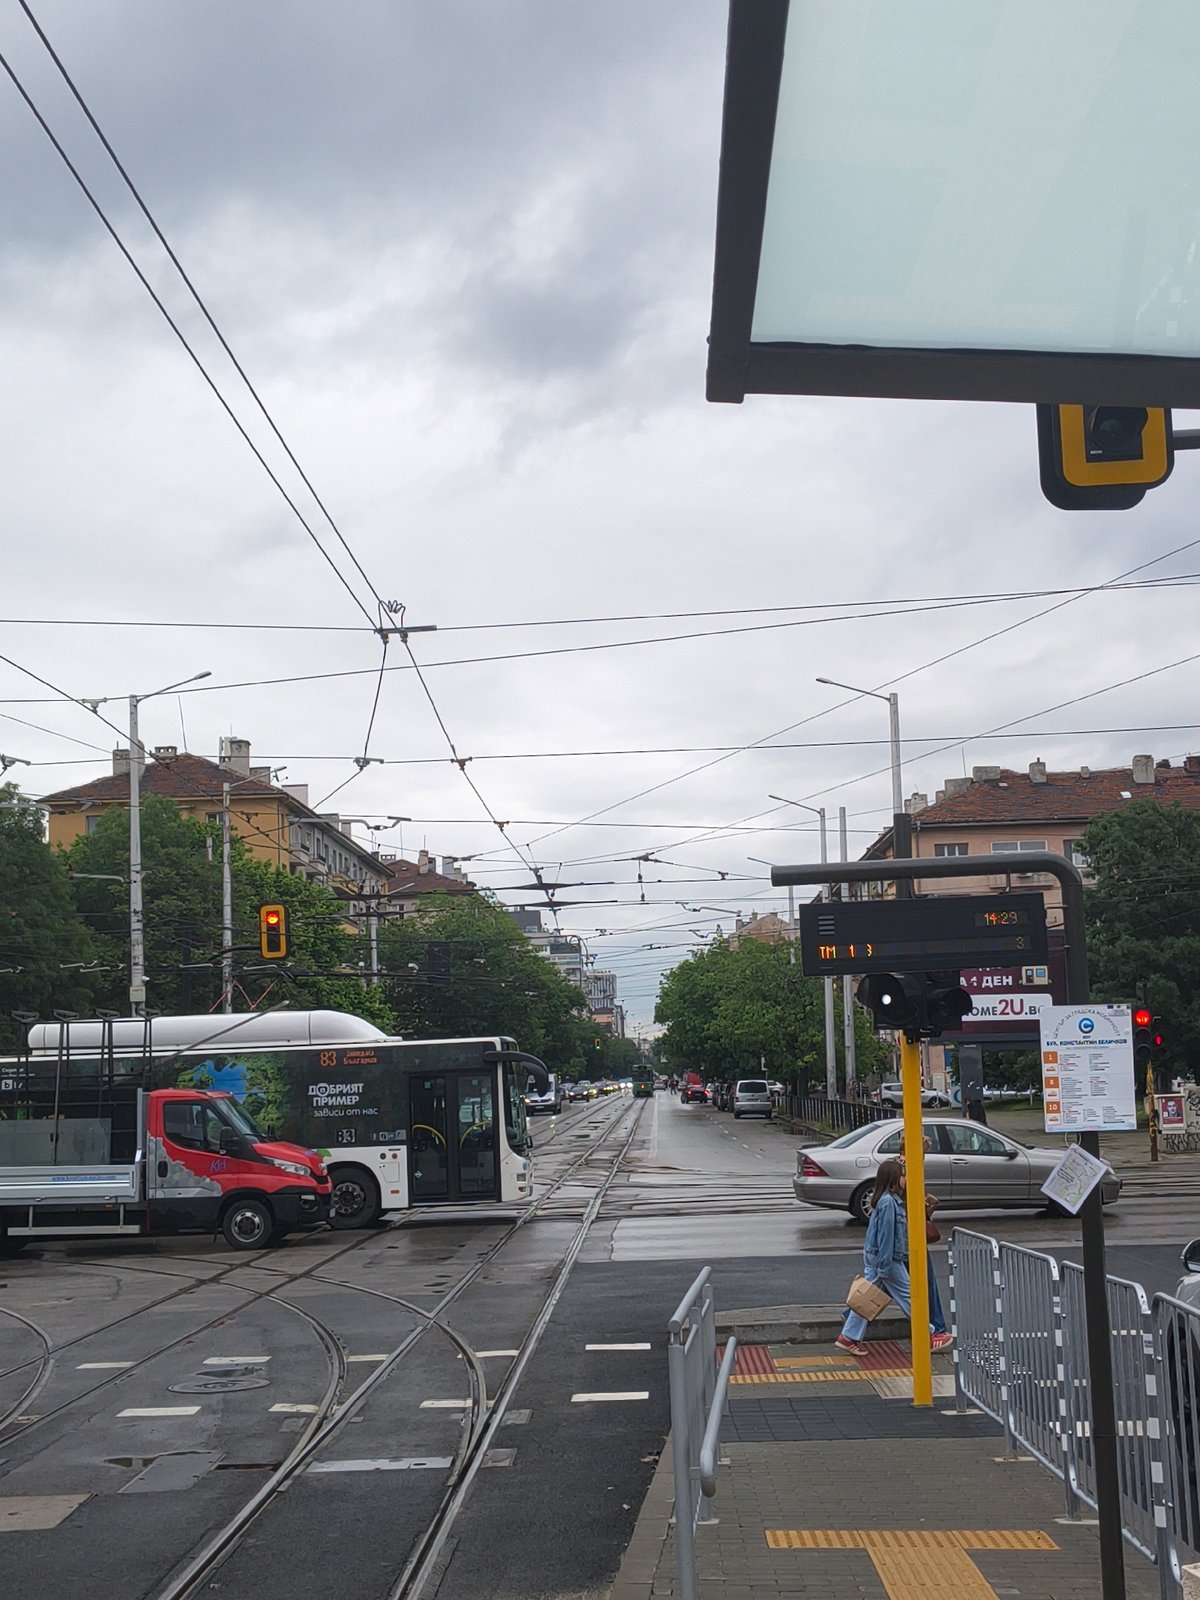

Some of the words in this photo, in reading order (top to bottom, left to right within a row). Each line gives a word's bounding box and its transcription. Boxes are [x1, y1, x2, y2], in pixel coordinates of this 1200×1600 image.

[984, 911, 1018, 926] 14:29
[981, 975, 1013, 988] ДЕН
[965, 998, 1041, 1017] OME2U.B
[320, 1051, 337, 1067] 83
[308, 1082, 364, 1097] ДОБРИЯТ
[313, 1095, 360, 1107] ПРИМЕР
[313, 1107, 345, 1118] зависи
[346, 1107, 361, 1116] от
[362, 1107, 379, 1115] нас
[337, 1129, 355, 1143] 83
